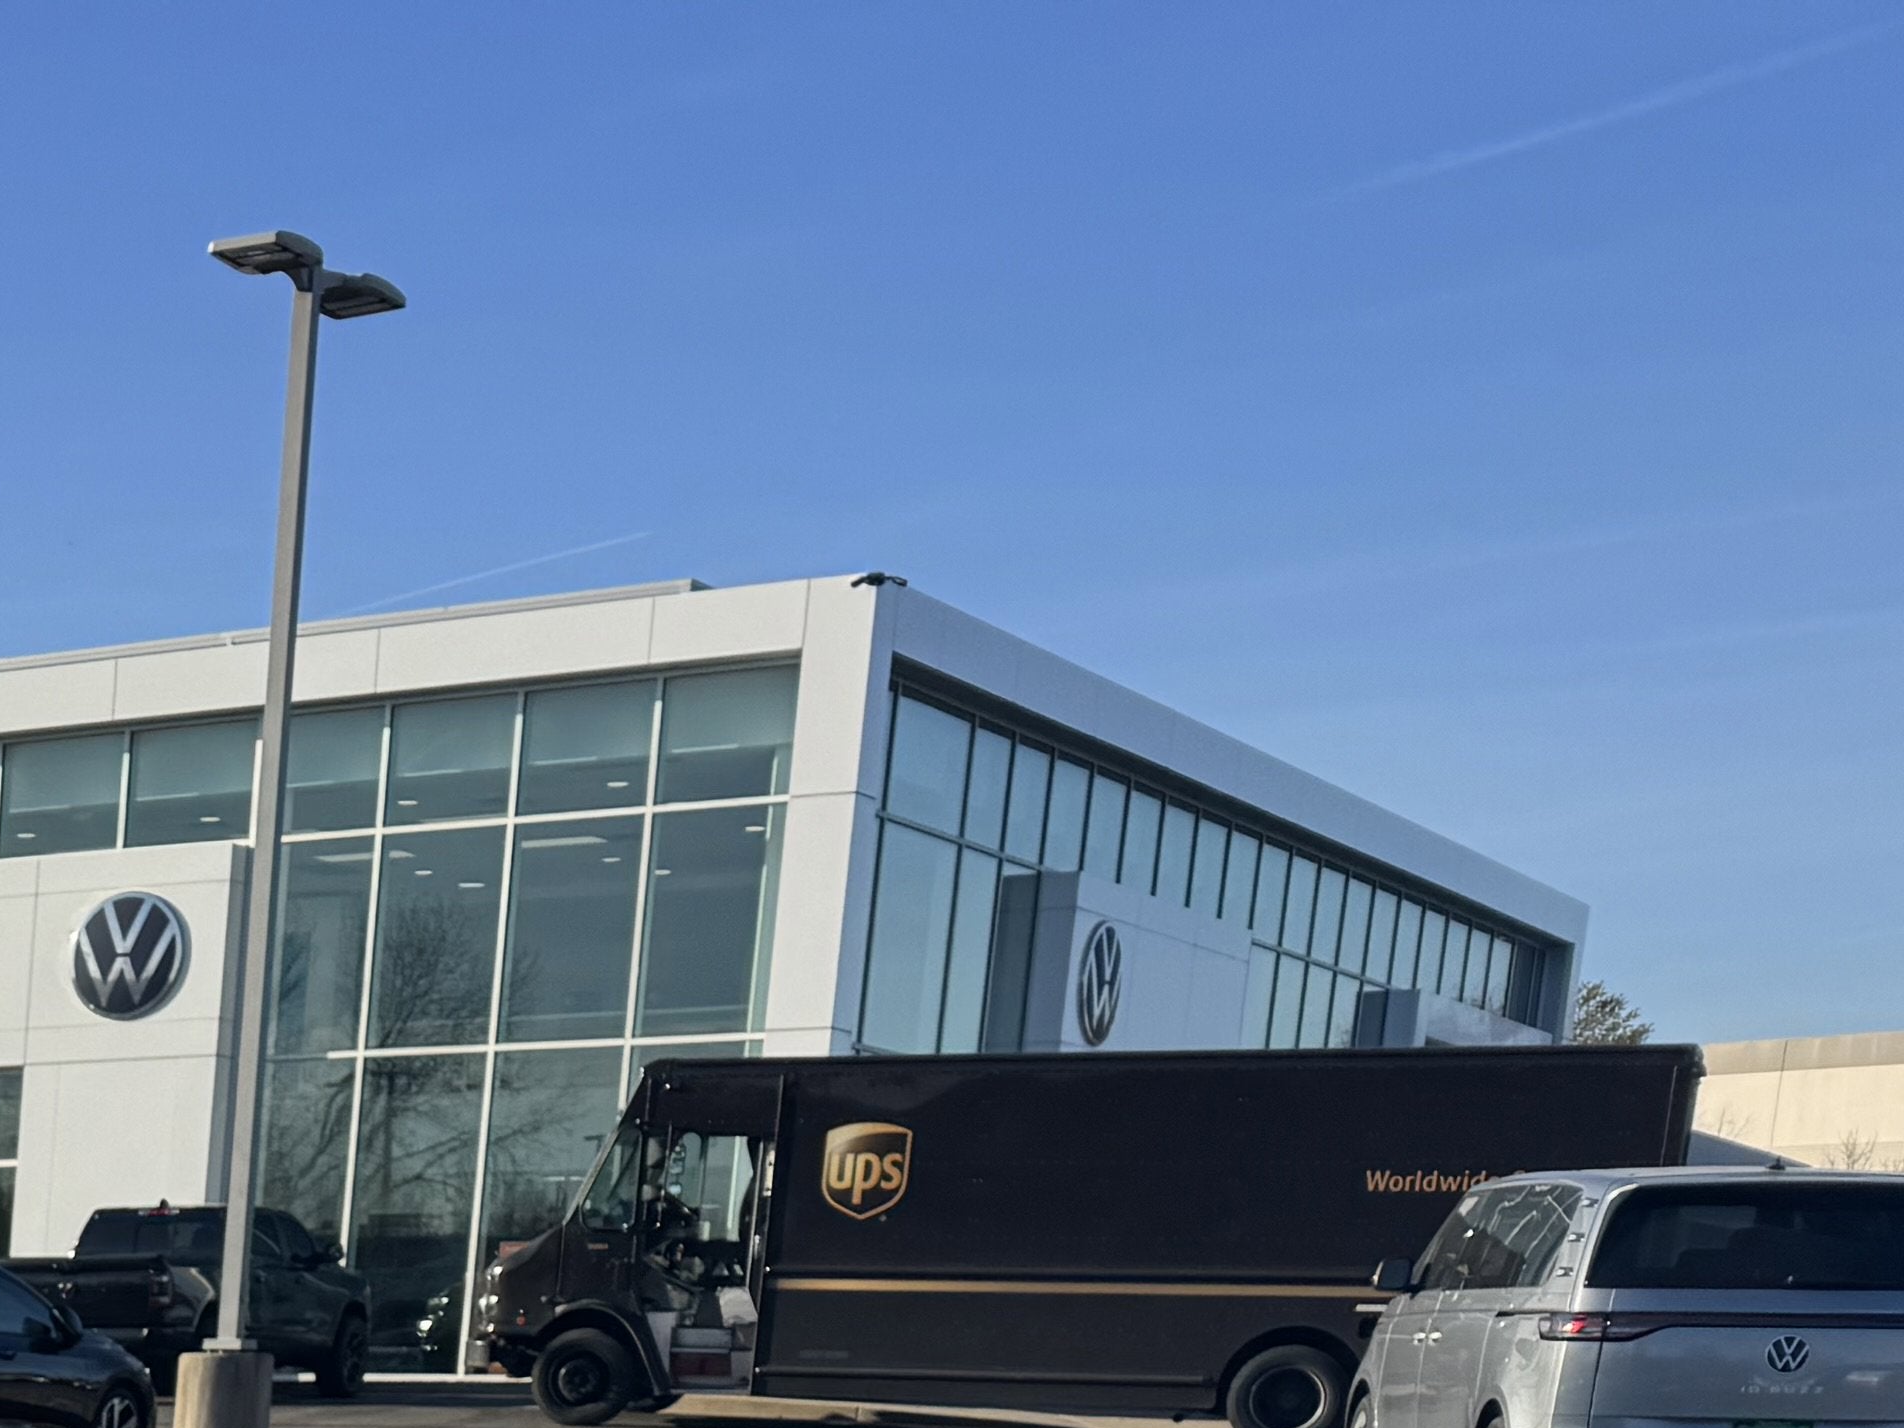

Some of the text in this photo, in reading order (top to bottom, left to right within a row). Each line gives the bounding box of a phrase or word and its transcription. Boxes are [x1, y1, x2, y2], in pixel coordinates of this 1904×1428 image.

[77, 892, 183, 1014] VW
[1079, 921, 1121, 1043] VW
[829, 1152, 903, 1205] ups
[1366, 1170, 1499, 1192] Worldwid
[1766, 1335, 1810, 1373] VW
